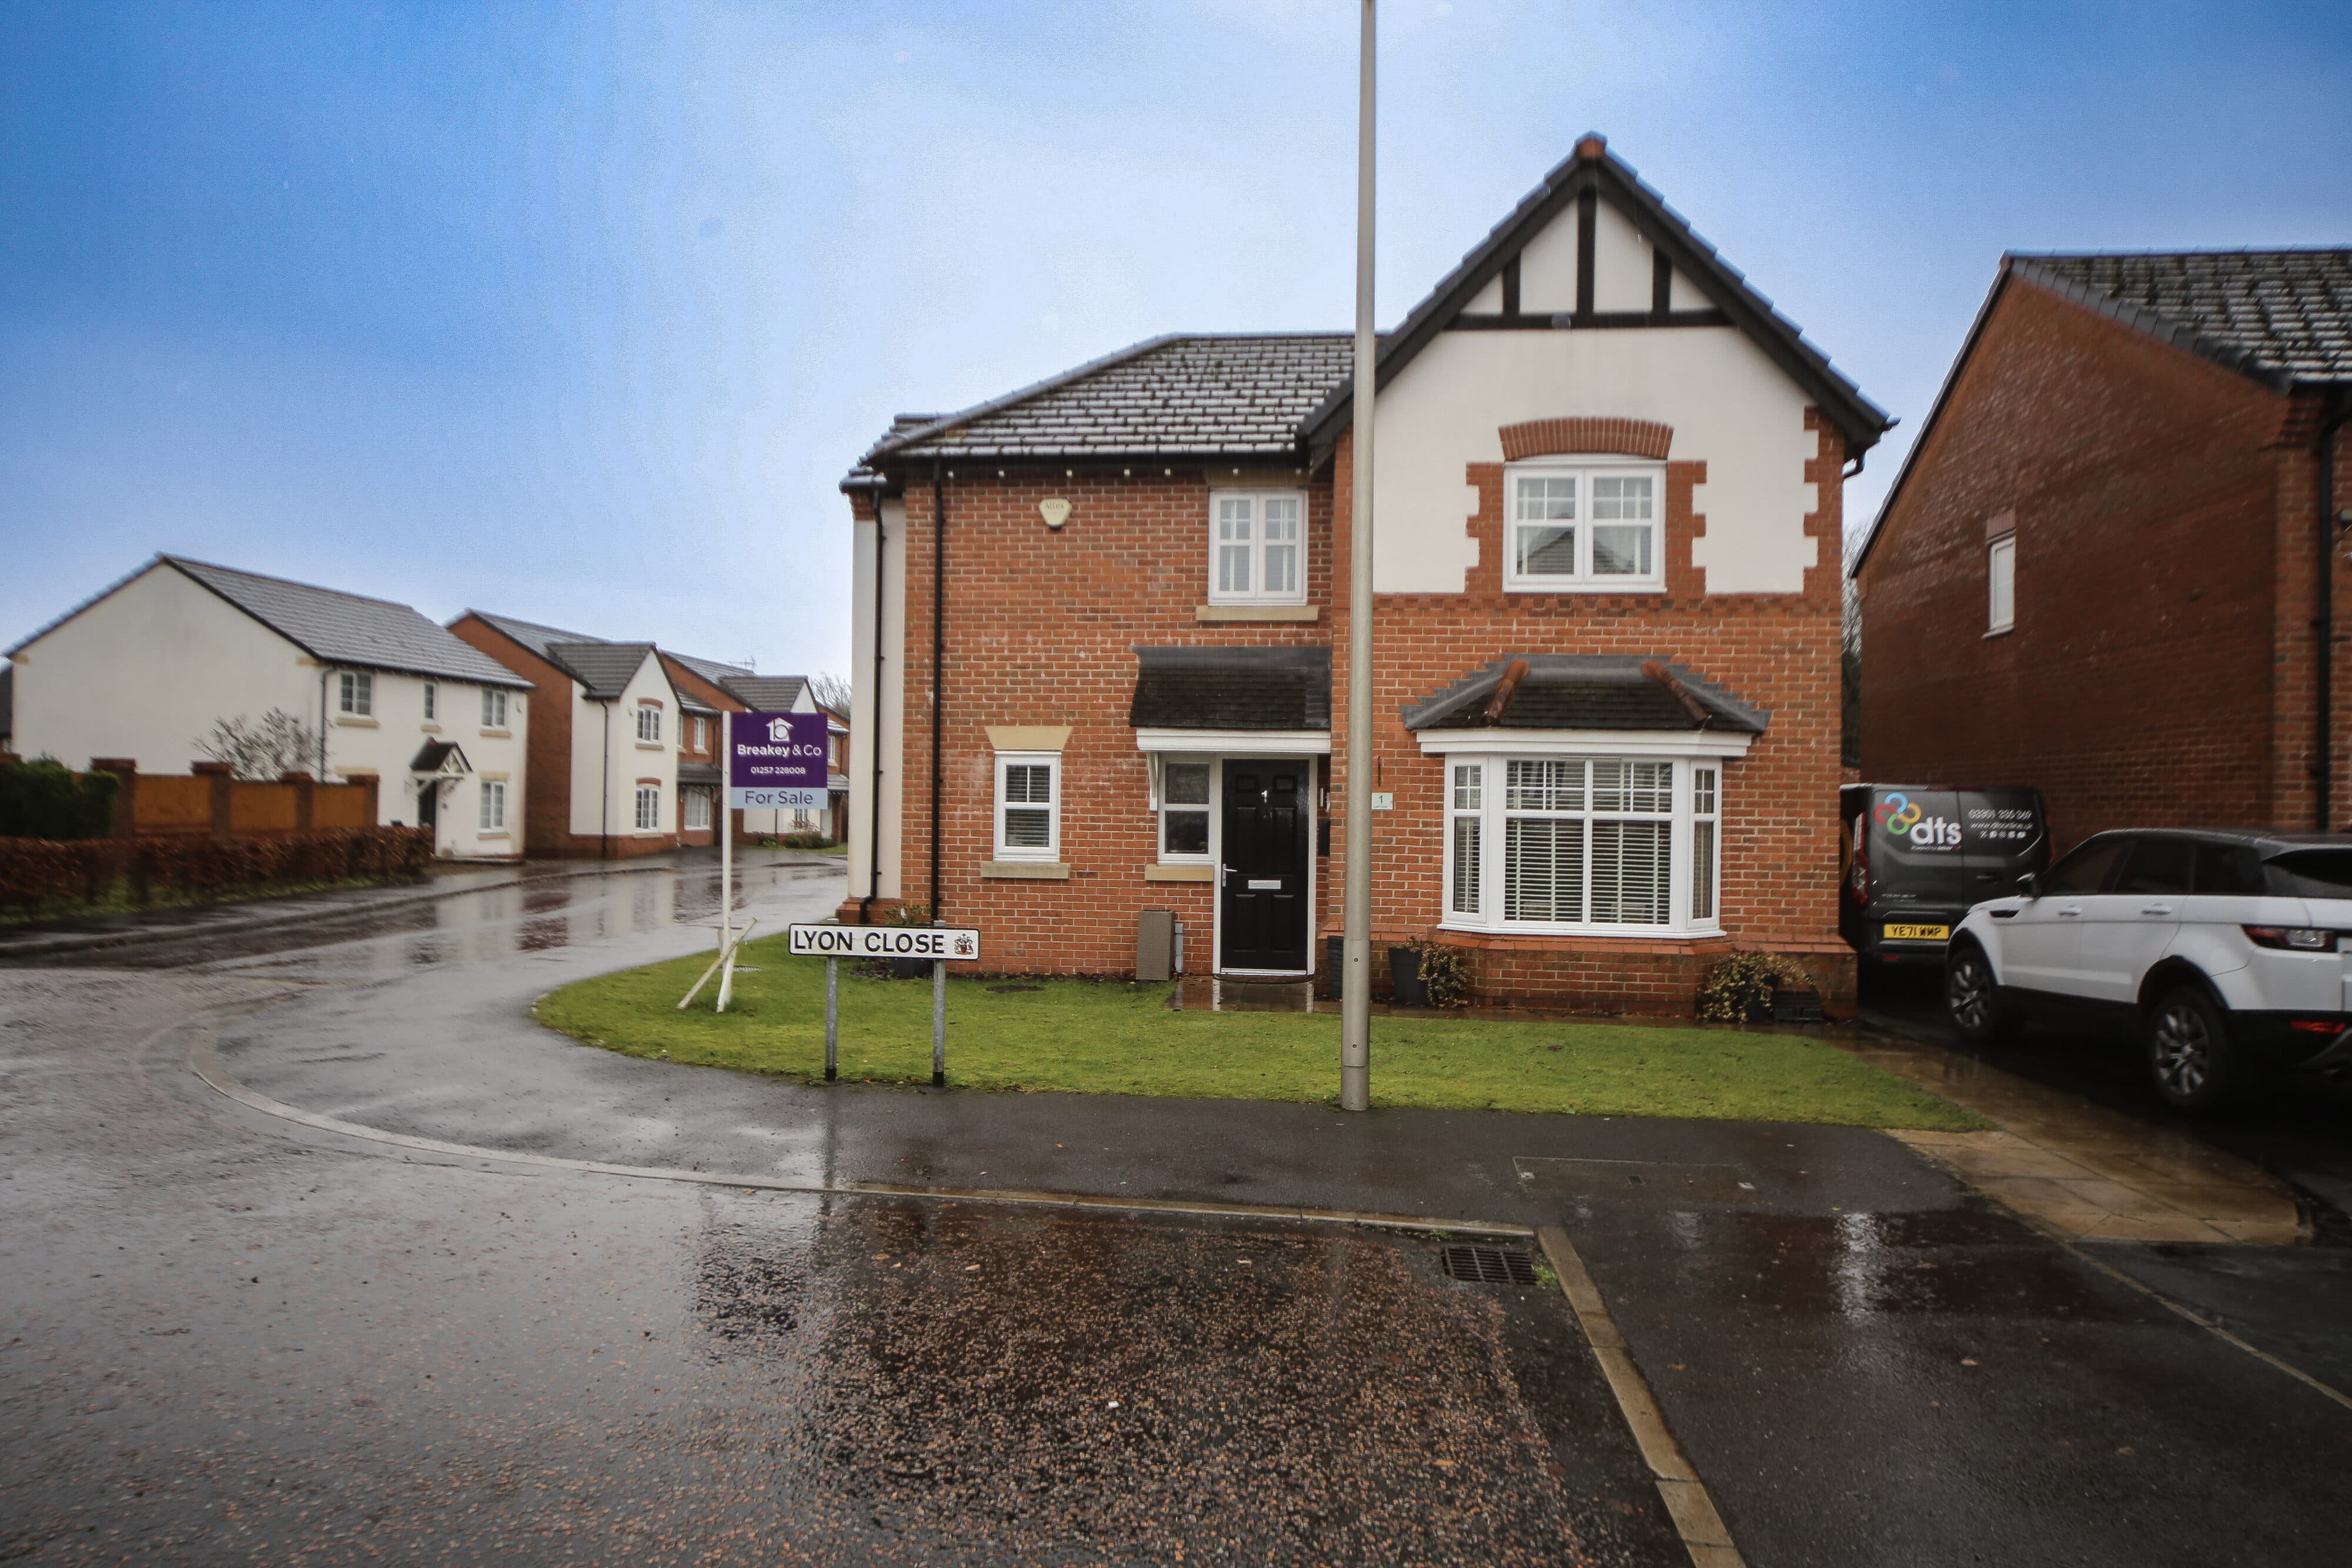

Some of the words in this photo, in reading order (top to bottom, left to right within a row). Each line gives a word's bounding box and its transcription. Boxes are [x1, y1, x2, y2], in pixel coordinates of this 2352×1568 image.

[737, 744, 790, 757] Breakey
[792, 744, 801, 755] &
[803, 744, 822, 756] Co
[750, 766, 773, 774] 01257
[774, 766, 806, 775] 228008
[745, 790, 773, 804] For
[778, 790, 813, 804] Sale
[1261, 790, 1267, 803] 1
[1378, 794, 1383, 804] 1
[1910, 816, 1962, 845] dts
[794, 930, 853, 951] LYON
[864, 932, 945, 954] CLOSE
